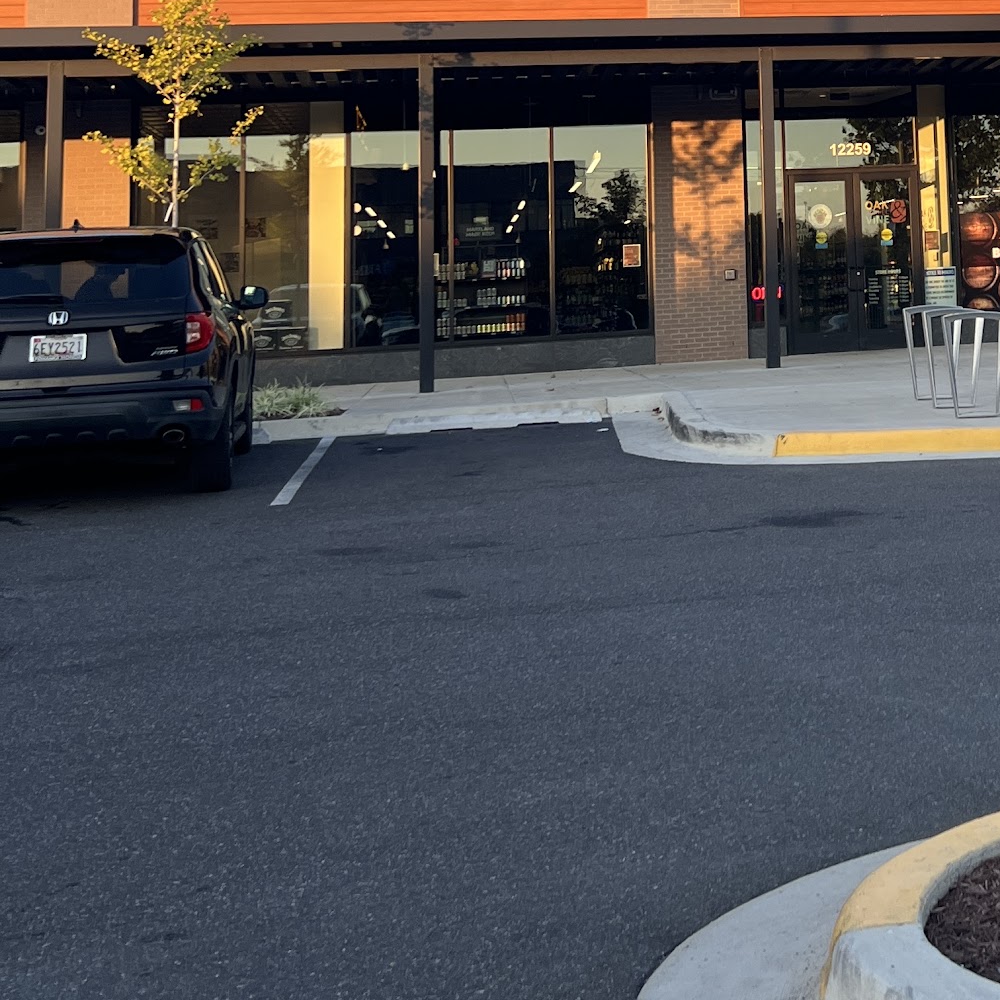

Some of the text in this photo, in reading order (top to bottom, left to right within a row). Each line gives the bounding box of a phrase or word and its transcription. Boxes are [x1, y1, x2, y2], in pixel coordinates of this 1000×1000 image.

[829, 142, 872, 156] 12259
[864, 200, 889, 211] OAK
[865, 215, 890, 225] VINE
[33, 341, 81, 356] 6EY2521
